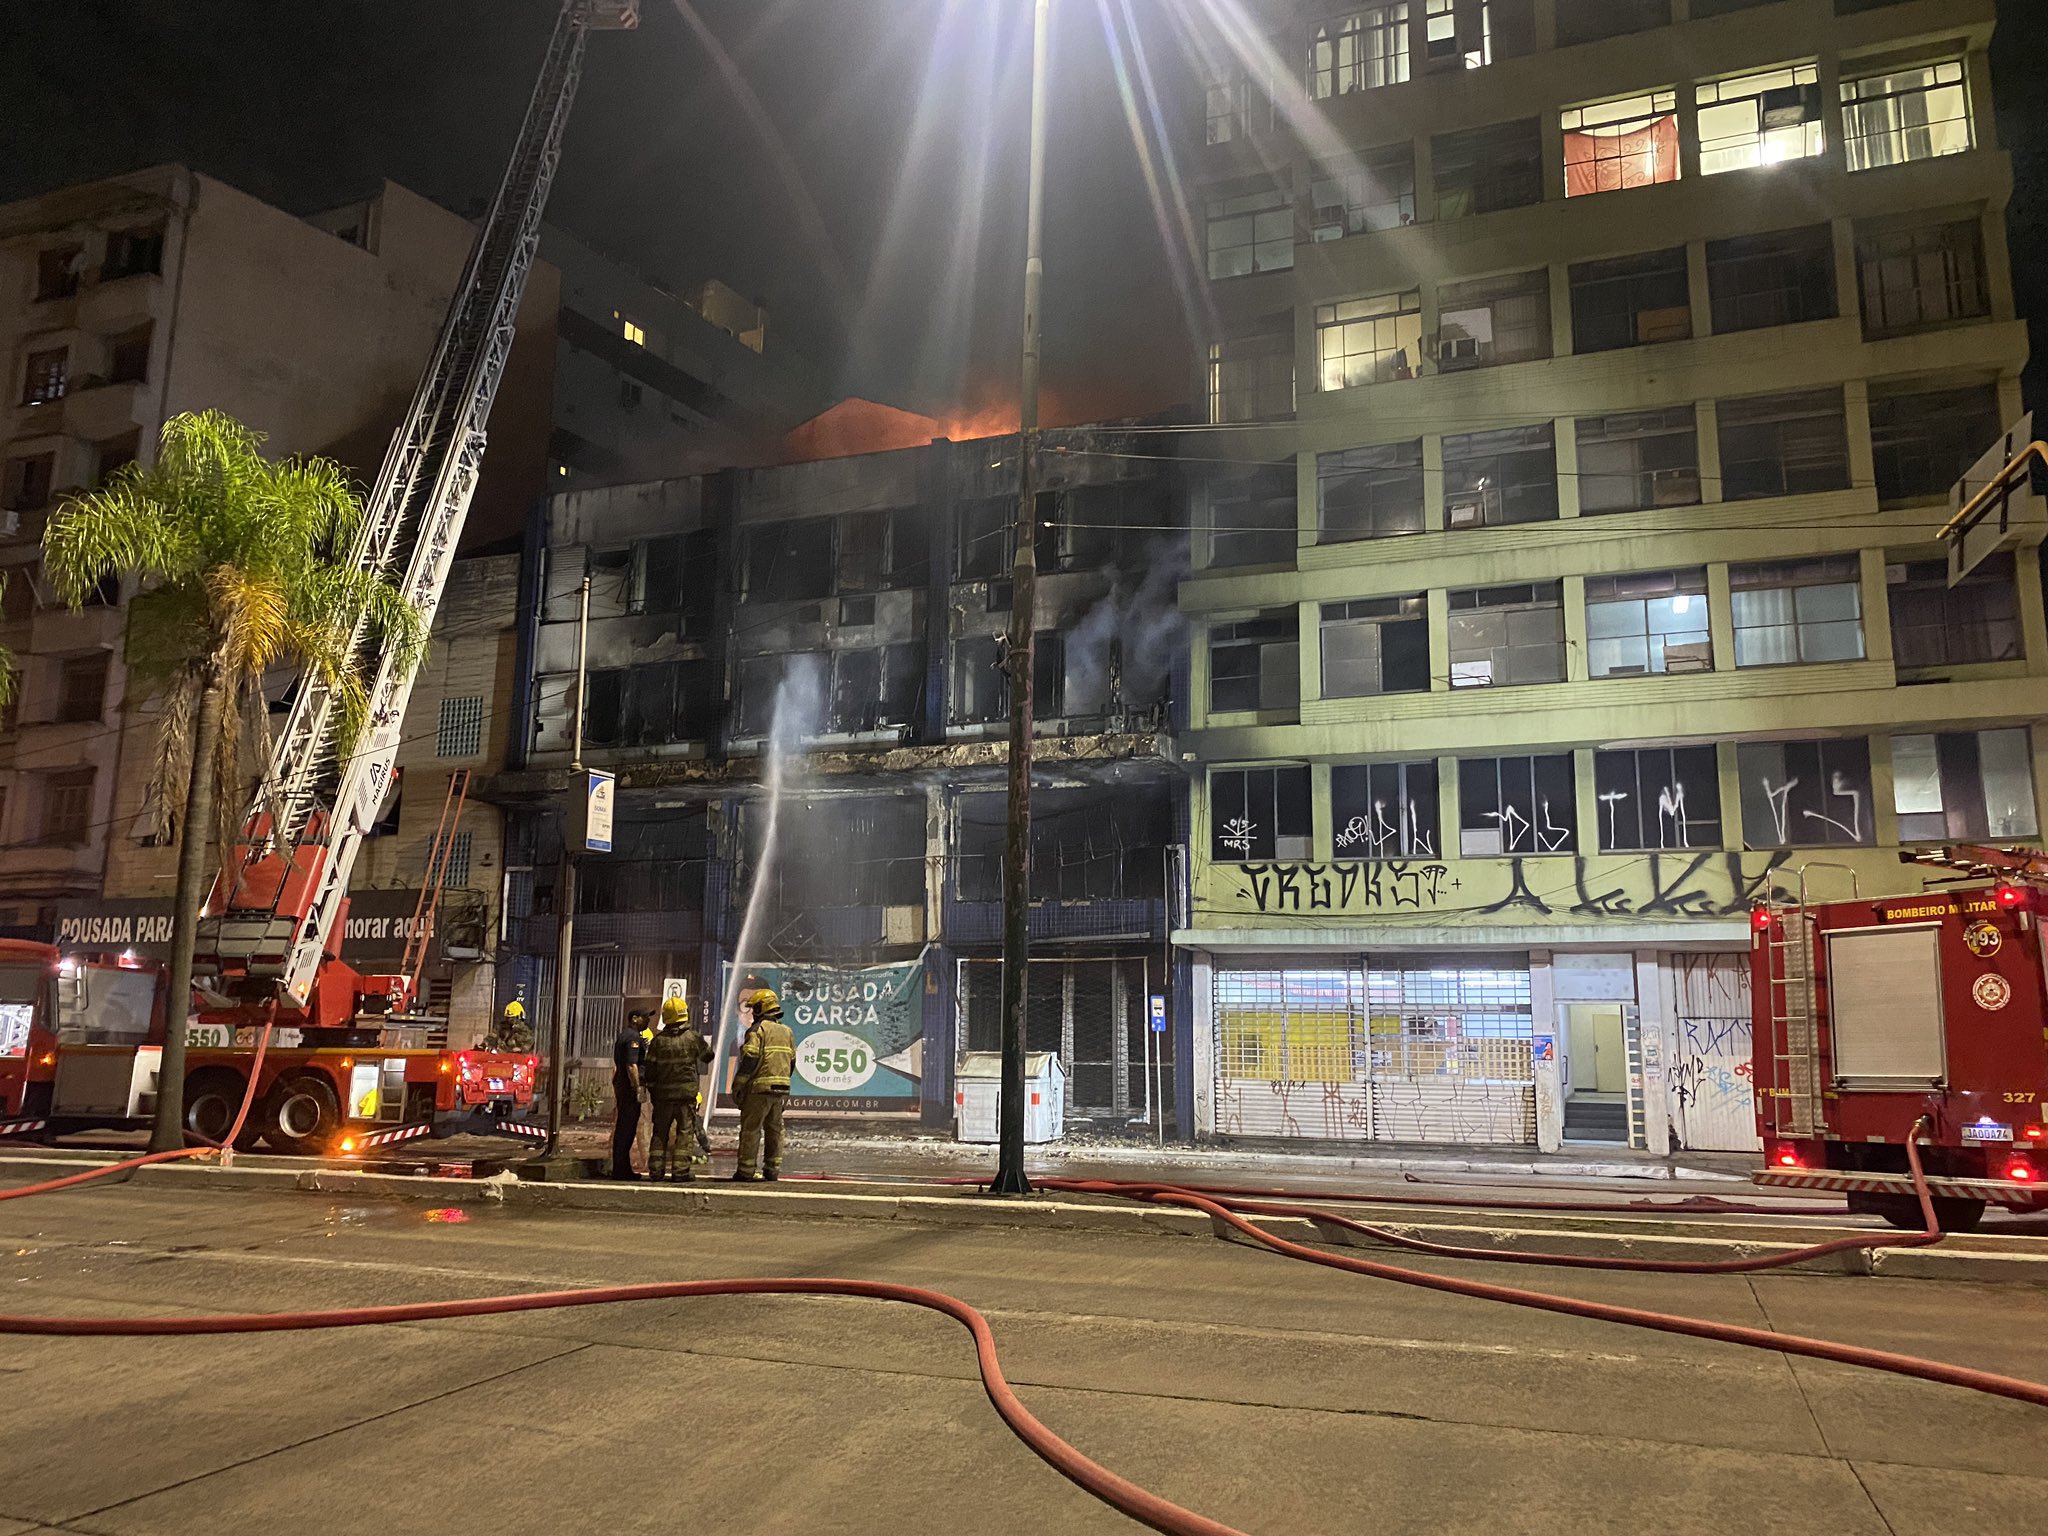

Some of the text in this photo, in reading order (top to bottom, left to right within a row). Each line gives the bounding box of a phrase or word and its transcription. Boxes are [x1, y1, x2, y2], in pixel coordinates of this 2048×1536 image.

[371, 757, 391, 805] MAGIRUS
[1886, 904, 1946, 920] BOMBEIRO
[61, 916, 132, 944] POUSADA
[1970, 930, 1999, 947] 193
[781, 979, 894, 1003] POUSADA
[794, 1003, 880, 1026] GAROA
[804, 1040, 816, 1049] Só
[815, 1074, 852, 1085] por mês
[2002, 1092, 2036, 1104] 327
